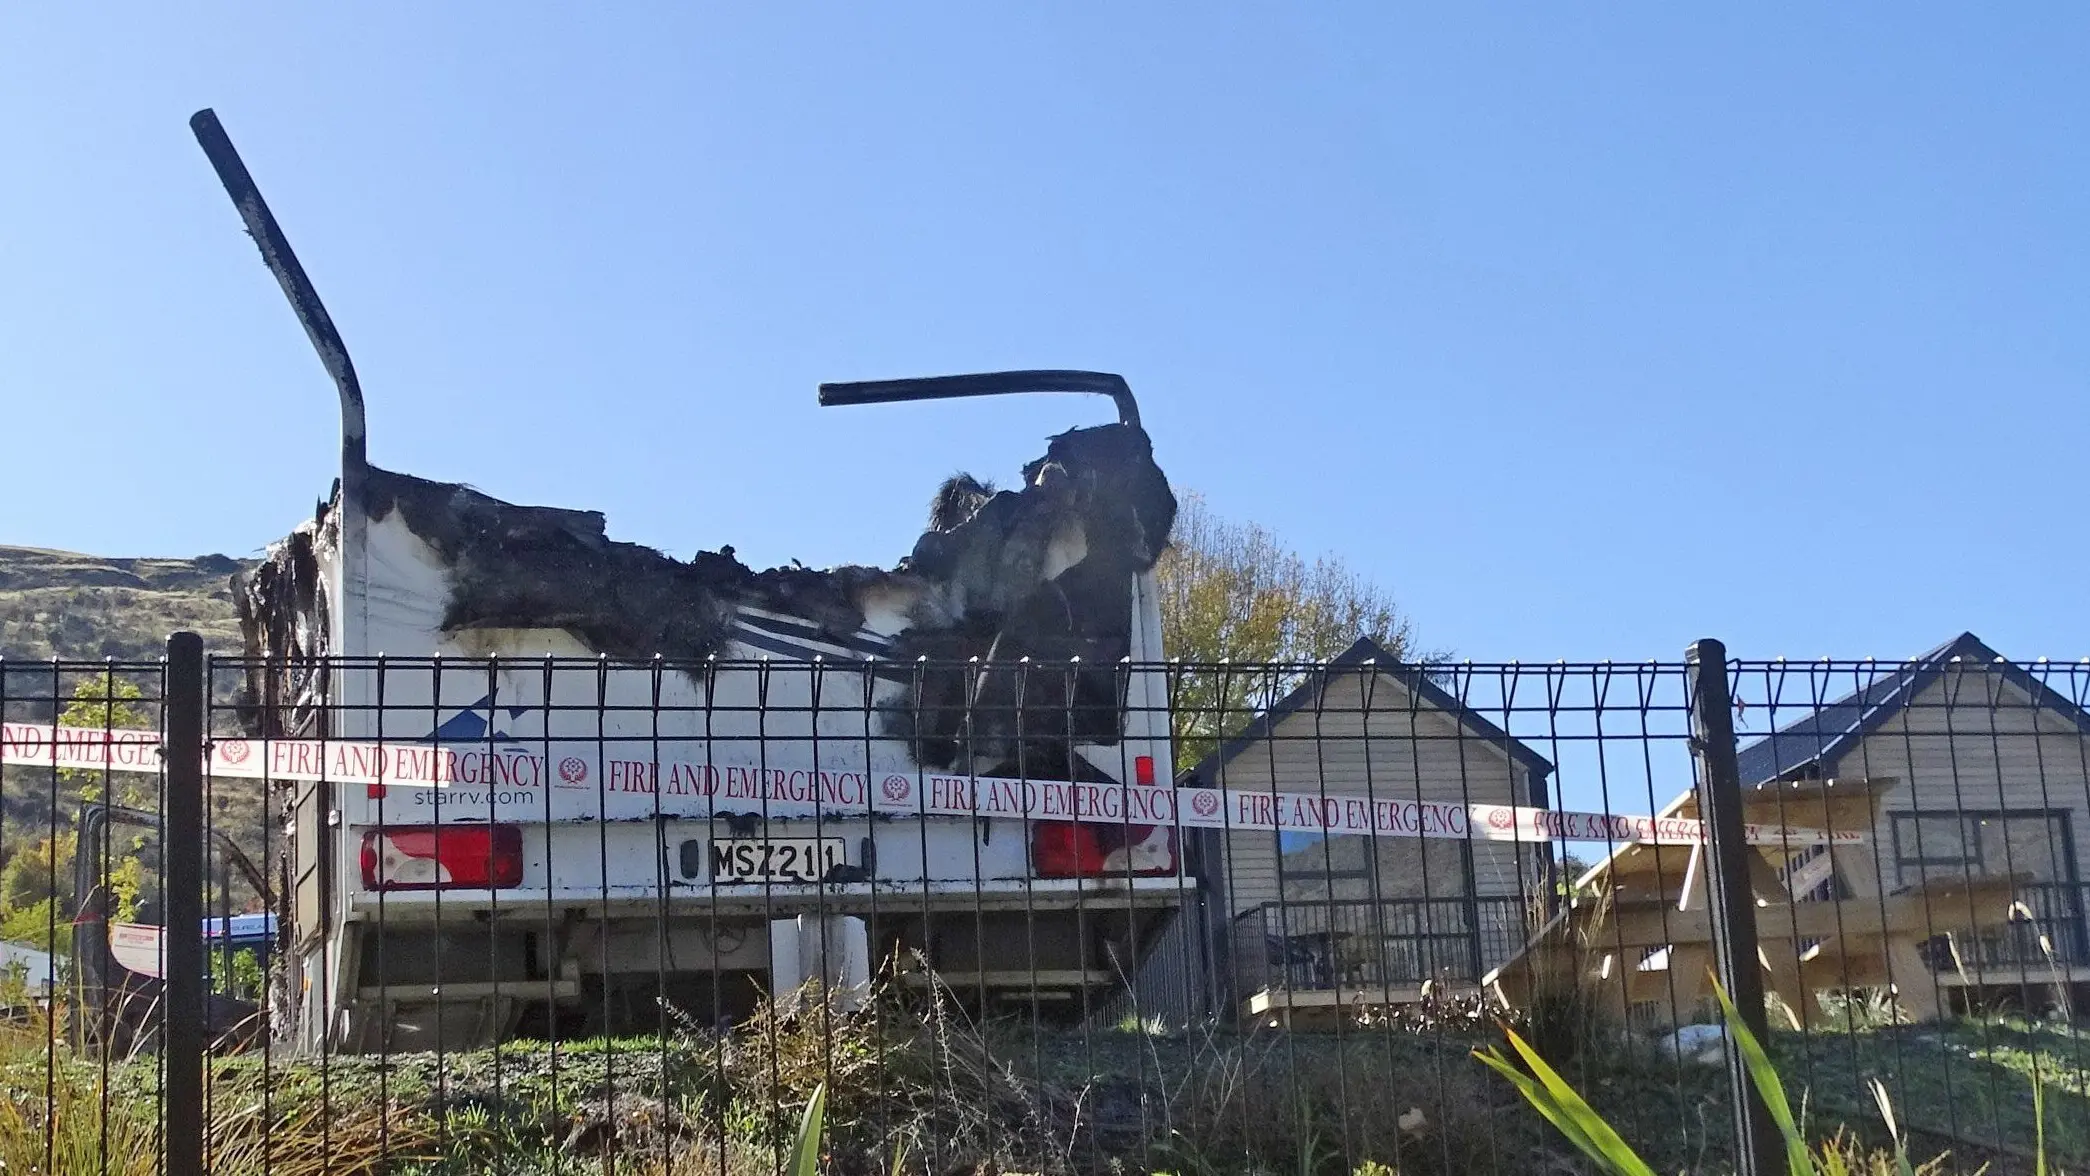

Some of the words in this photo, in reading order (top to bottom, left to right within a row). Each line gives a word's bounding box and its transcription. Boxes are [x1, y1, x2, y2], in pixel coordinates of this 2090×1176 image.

[0, 726, 41, 760] ND
[48, 728, 166, 766] EMERGE
[272, 742, 323, 775] FIRE
[332, 744, 388, 778] AND
[394, 748, 544, 788] EMERGENCY
[414, 788, 534, 805] starrv.com
[609, 760, 661, 793] FIRE
[666, 764, 720, 797] AND
[725, 767, 868, 805] EMERGENCY
[930, 778, 980, 812] FIRE
[986, 780, 1037, 814] AND
[1042, 783, 1178, 821] EMERGENCY
[1238, 794, 1287, 826] FIRE
[1291, 798, 1340, 829] AND
[1345, 799, 1479, 835] EMERGENCY
[712, 845, 834, 877] MSZ211
